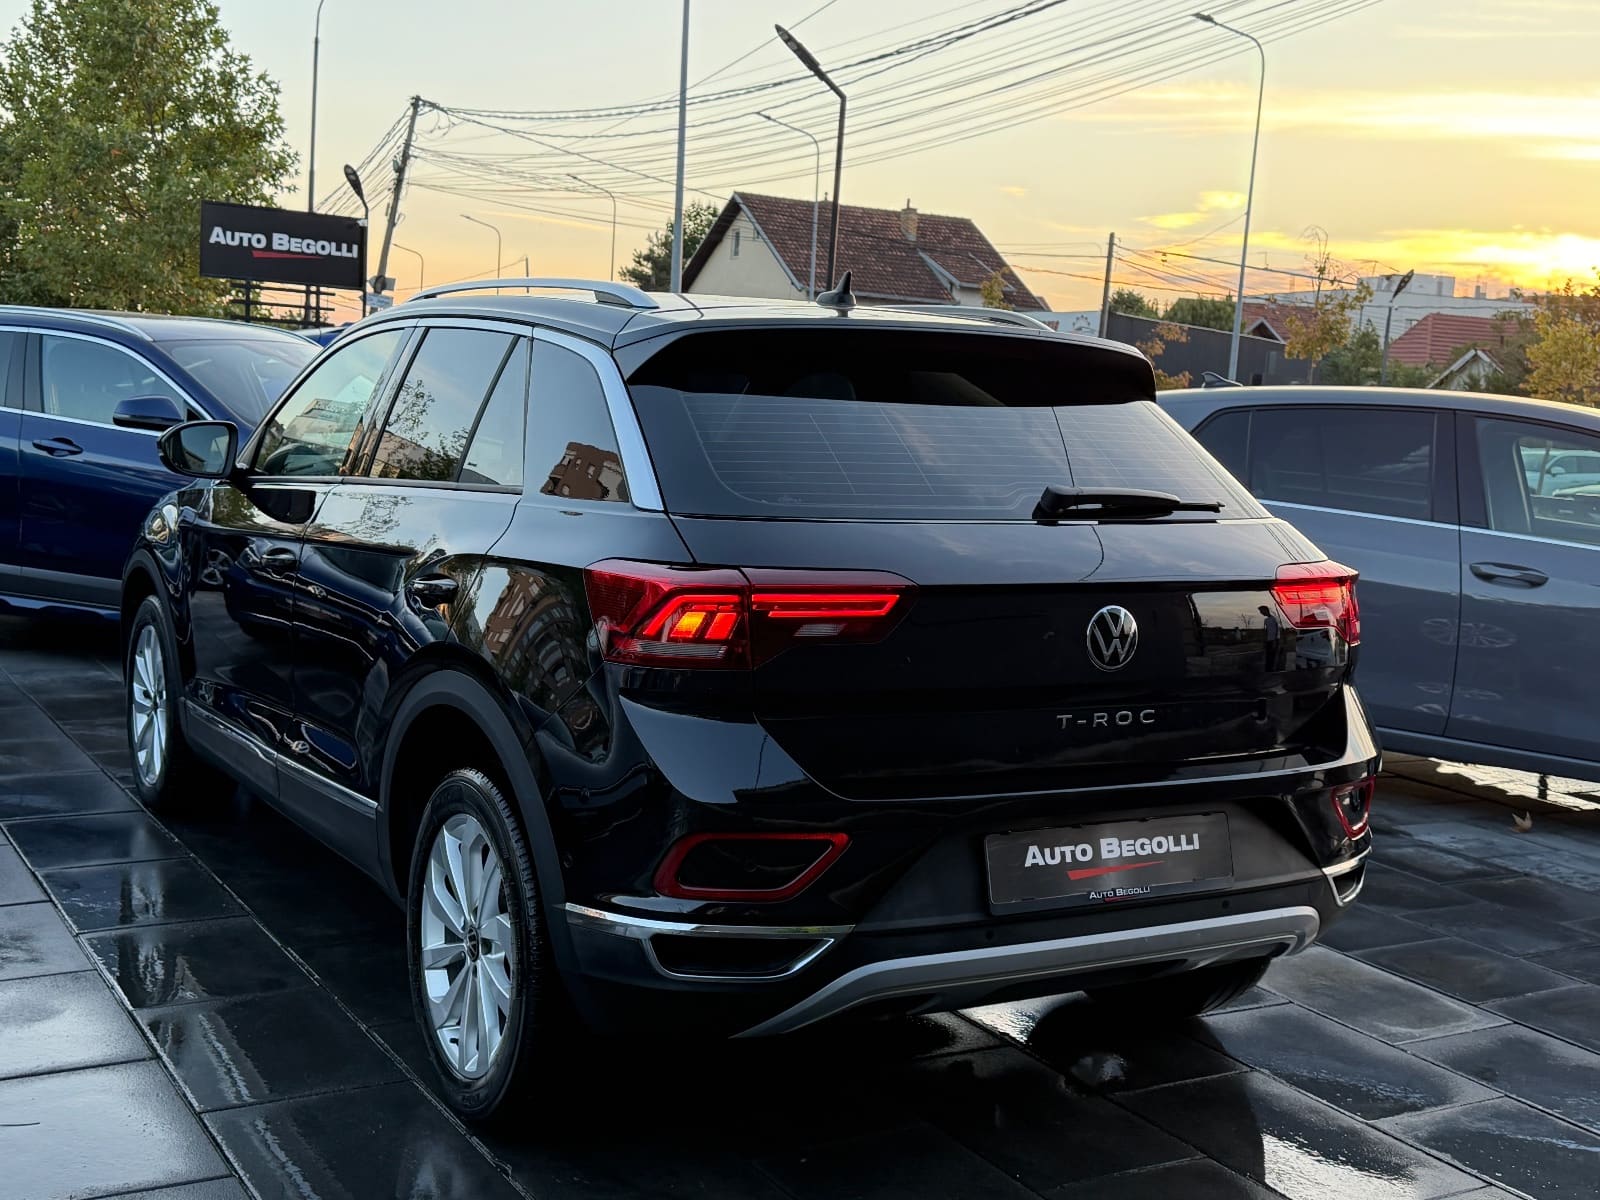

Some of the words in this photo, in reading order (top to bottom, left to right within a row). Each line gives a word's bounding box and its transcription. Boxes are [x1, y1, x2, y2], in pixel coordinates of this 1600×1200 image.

[209, 226, 267, 249] AUTO
[272, 232, 359, 259] BEGOLLI
[1056, 709, 1156, 729] T-ROC
[1024, 843, 1093, 868] AUTO
[1100, 833, 1200, 860] BEGOLLI
[1089, 889, 1114, 901] AUTO
[1116, 886, 1151, 898] BEGOLLI
